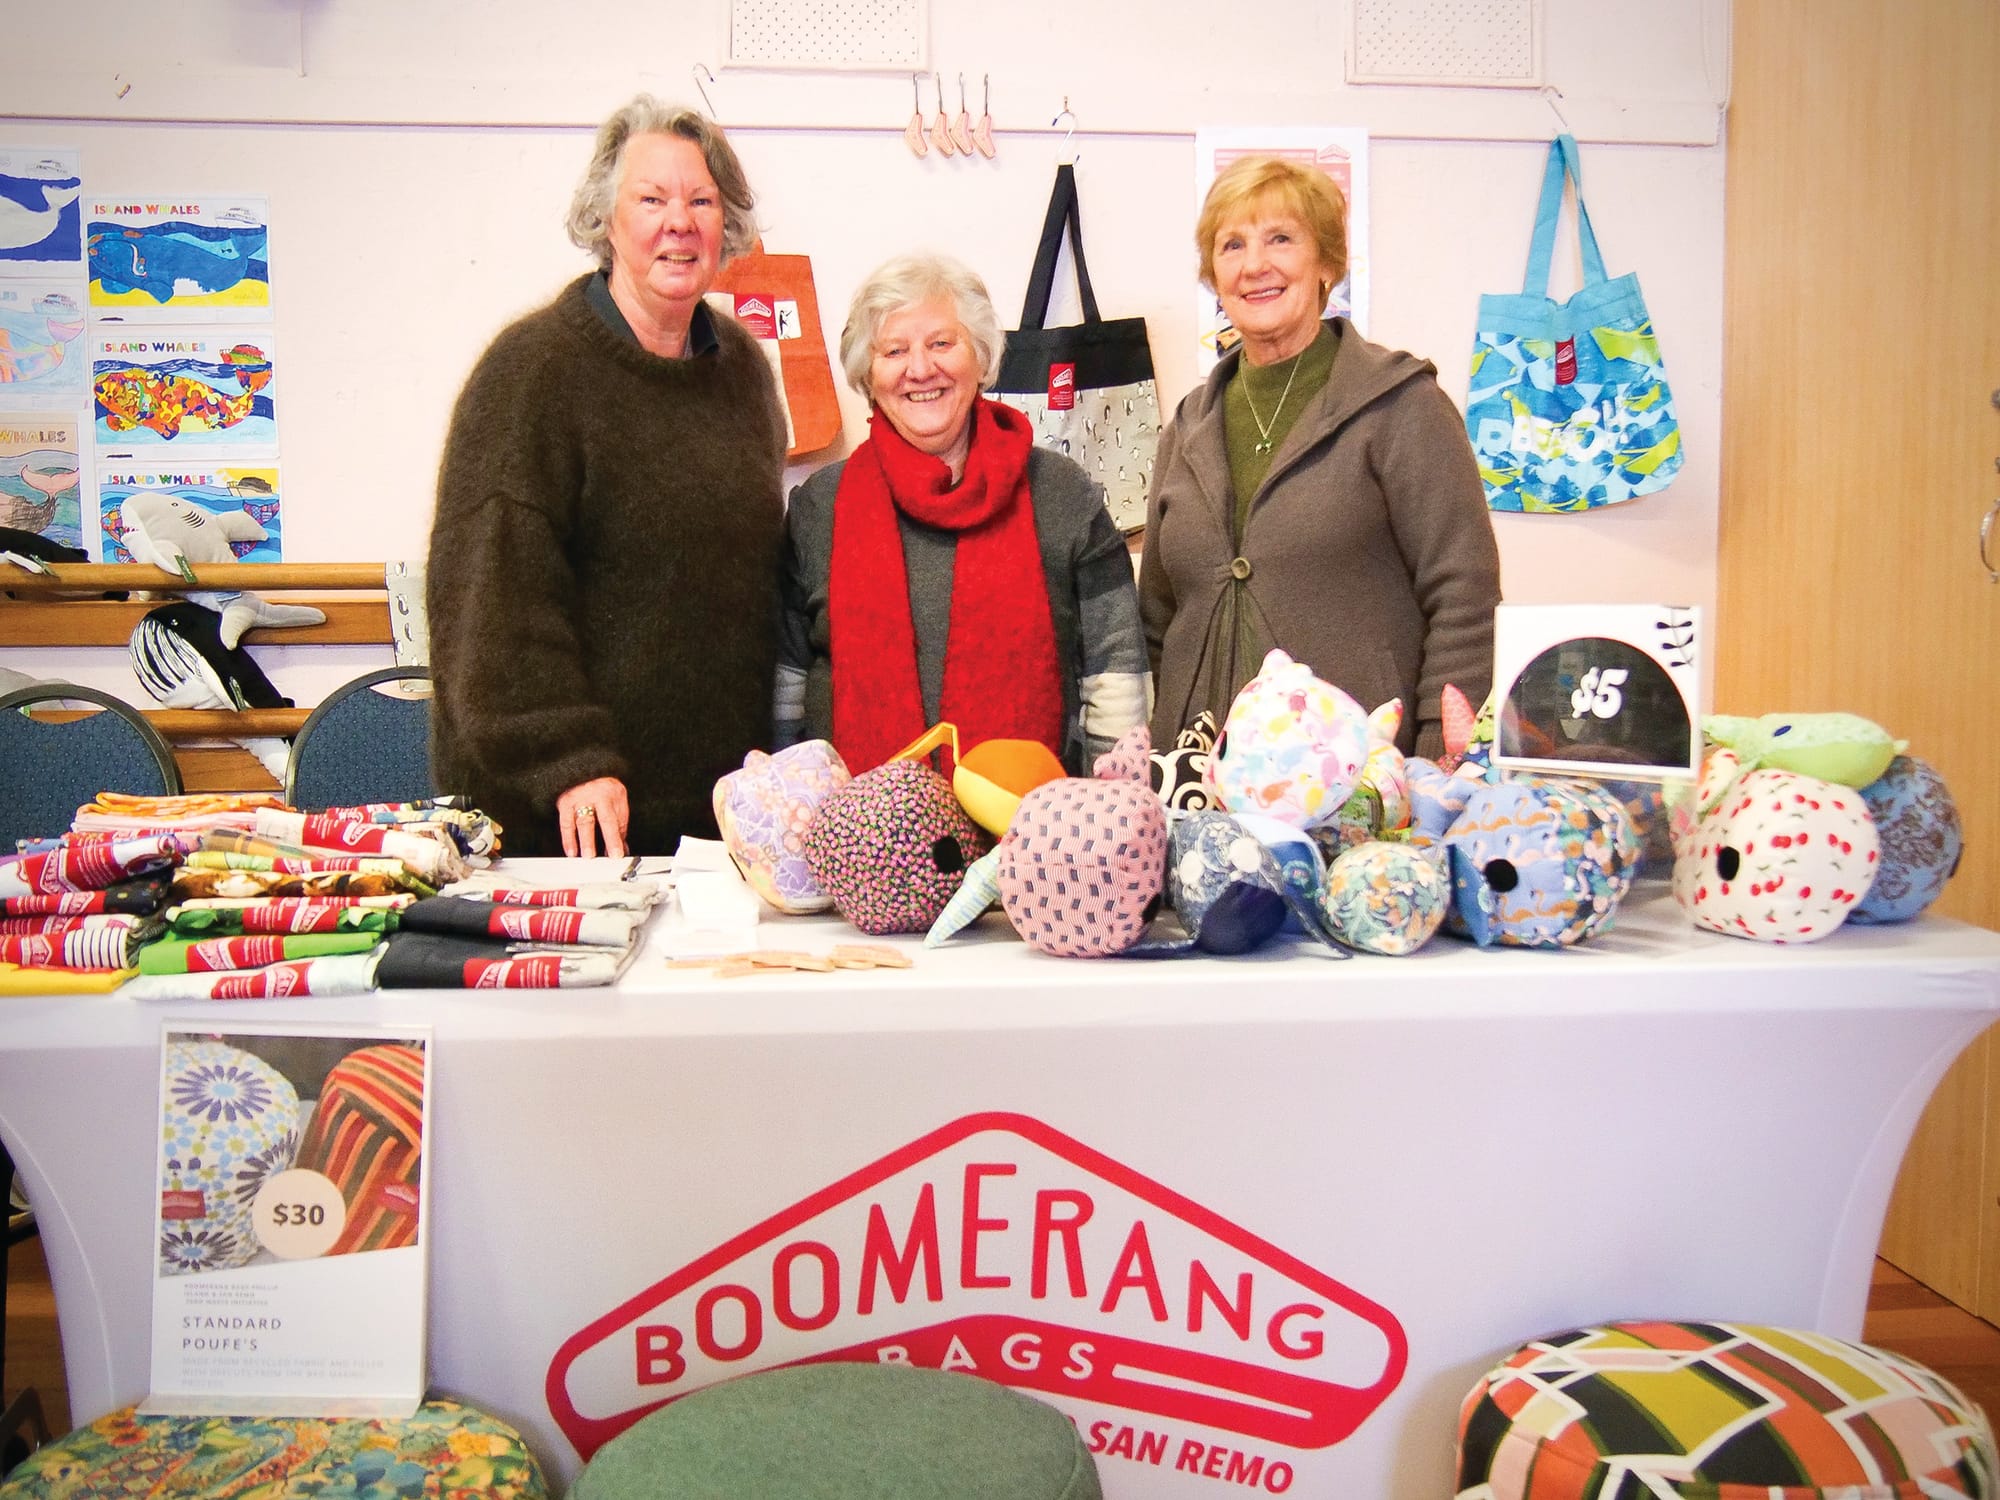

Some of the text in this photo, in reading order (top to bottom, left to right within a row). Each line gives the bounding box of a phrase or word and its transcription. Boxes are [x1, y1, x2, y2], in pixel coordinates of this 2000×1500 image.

[95, 204, 200, 215] ISLAND WHALES
[100, 342, 206, 353] ISLAND WHALES
[108, 474, 213, 485] ISLAND WHALES
[1571, 666, 1628, 719] $5
[273, 1203, 324, 1226] $30
[636, 1163, 1324, 1386] BOOMERANG
[182, 1316, 282, 1330] STANDARD
[182, 1338, 258, 1351] POUFE'S
[1087, 1420, 1294, 1494] SAN REMO
